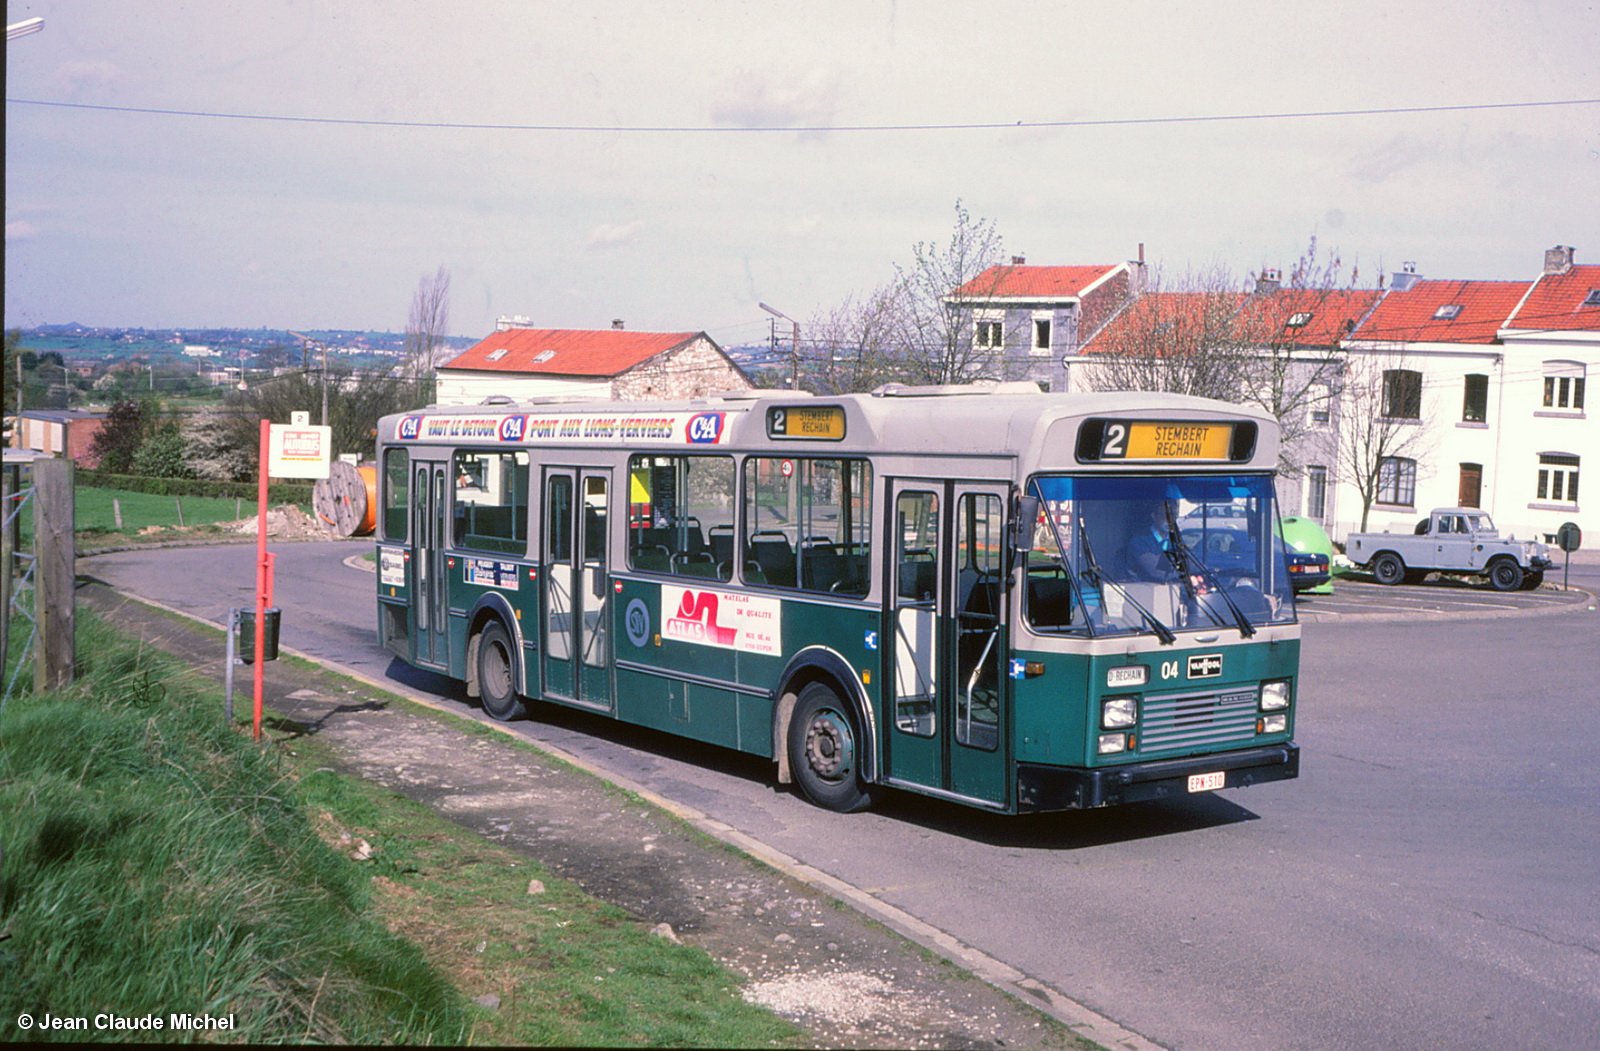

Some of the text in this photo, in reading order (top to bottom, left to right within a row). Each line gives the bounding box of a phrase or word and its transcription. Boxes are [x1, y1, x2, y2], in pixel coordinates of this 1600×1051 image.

[774, 410, 785, 431] 2
[800, 410, 833, 421] STEMBERT
[428, 420, 450, 436] VAUT
[450, 420, 460, 436] LE
[462, 419, 498, 437] DETOUR
[502, 416, 522, 438] C&A
[530, 419, 559, 438] PONT
[560, 419, 584, 438] AUX
[690, 415, 717, 440] C&A
[1155, 427, 1209, 441] STEMBERT
[1104, 424, 1126, 455] 2
[1156, 442, 1202, 457] RECHAIN
[668, 620, 702, 640] ATLAS
[1161, 661, 1179, 680] 04
